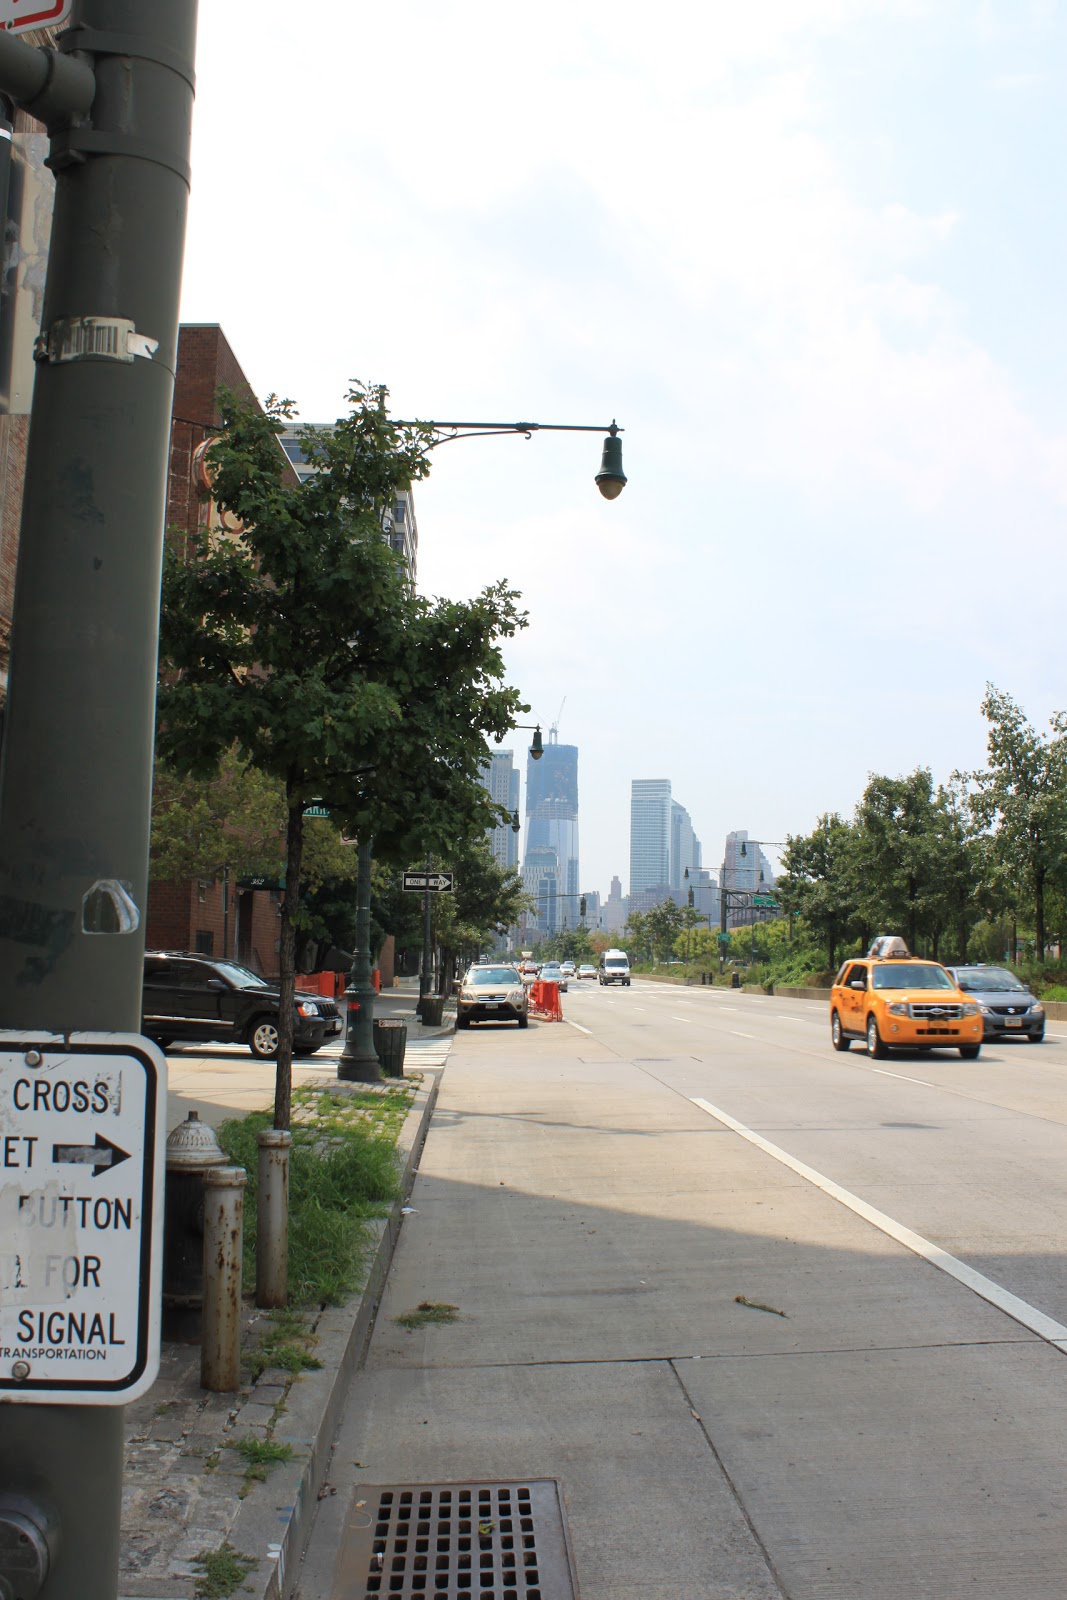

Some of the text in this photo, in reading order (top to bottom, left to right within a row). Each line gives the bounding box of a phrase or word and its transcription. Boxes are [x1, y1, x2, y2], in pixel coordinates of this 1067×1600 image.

[13, 1078, 109, 1113] CROSS
[0, 1135, 39, 1168] ET
[19, 1195, 132, 1230] BUTTON
[45, 1255, 101, 1287] FOR
[17, 1309, 125, 1345] SIGNAL
[0, 1347, 106, 1360] TRANSPORTATION
